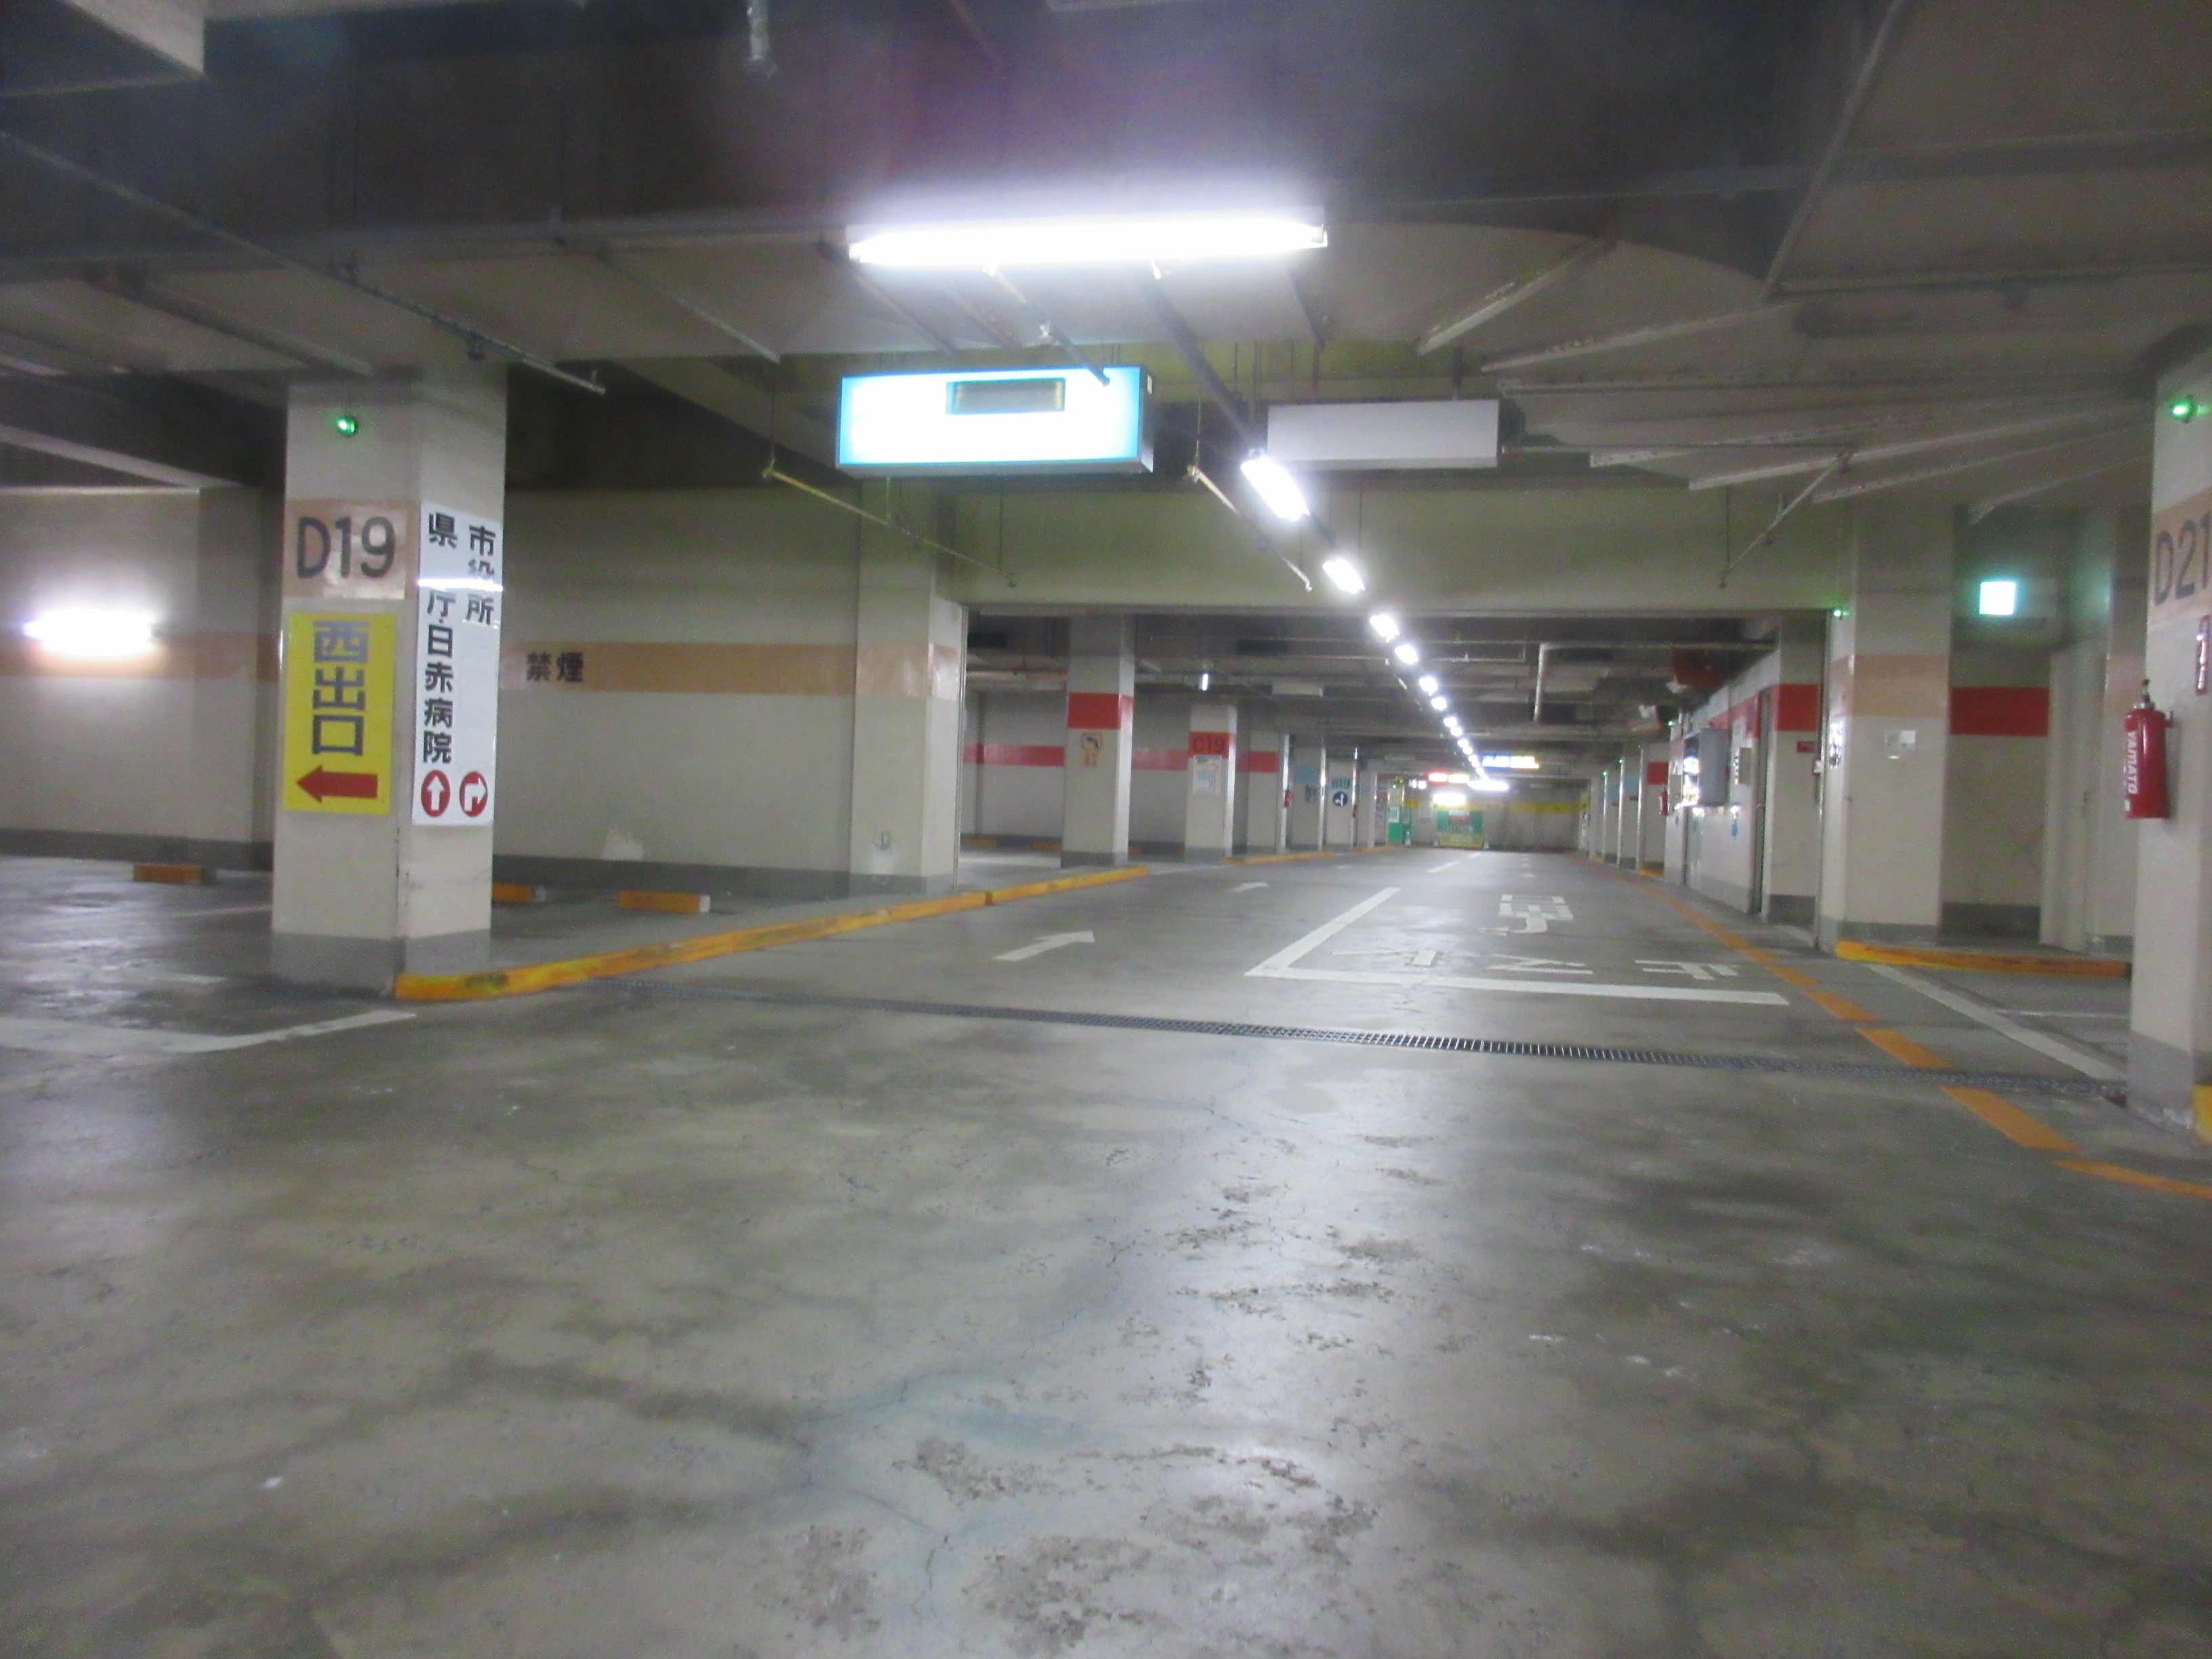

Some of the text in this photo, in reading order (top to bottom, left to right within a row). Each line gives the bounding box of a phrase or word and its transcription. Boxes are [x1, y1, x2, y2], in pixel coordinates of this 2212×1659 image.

[296, 516, 396, 579] D19
[2155, 512, 2212, 605] D21
[312, 620, 371, 756] 西出口
[527, 651, 583, 682] 禁煙
[1193, 736, 1225, 754] C19
